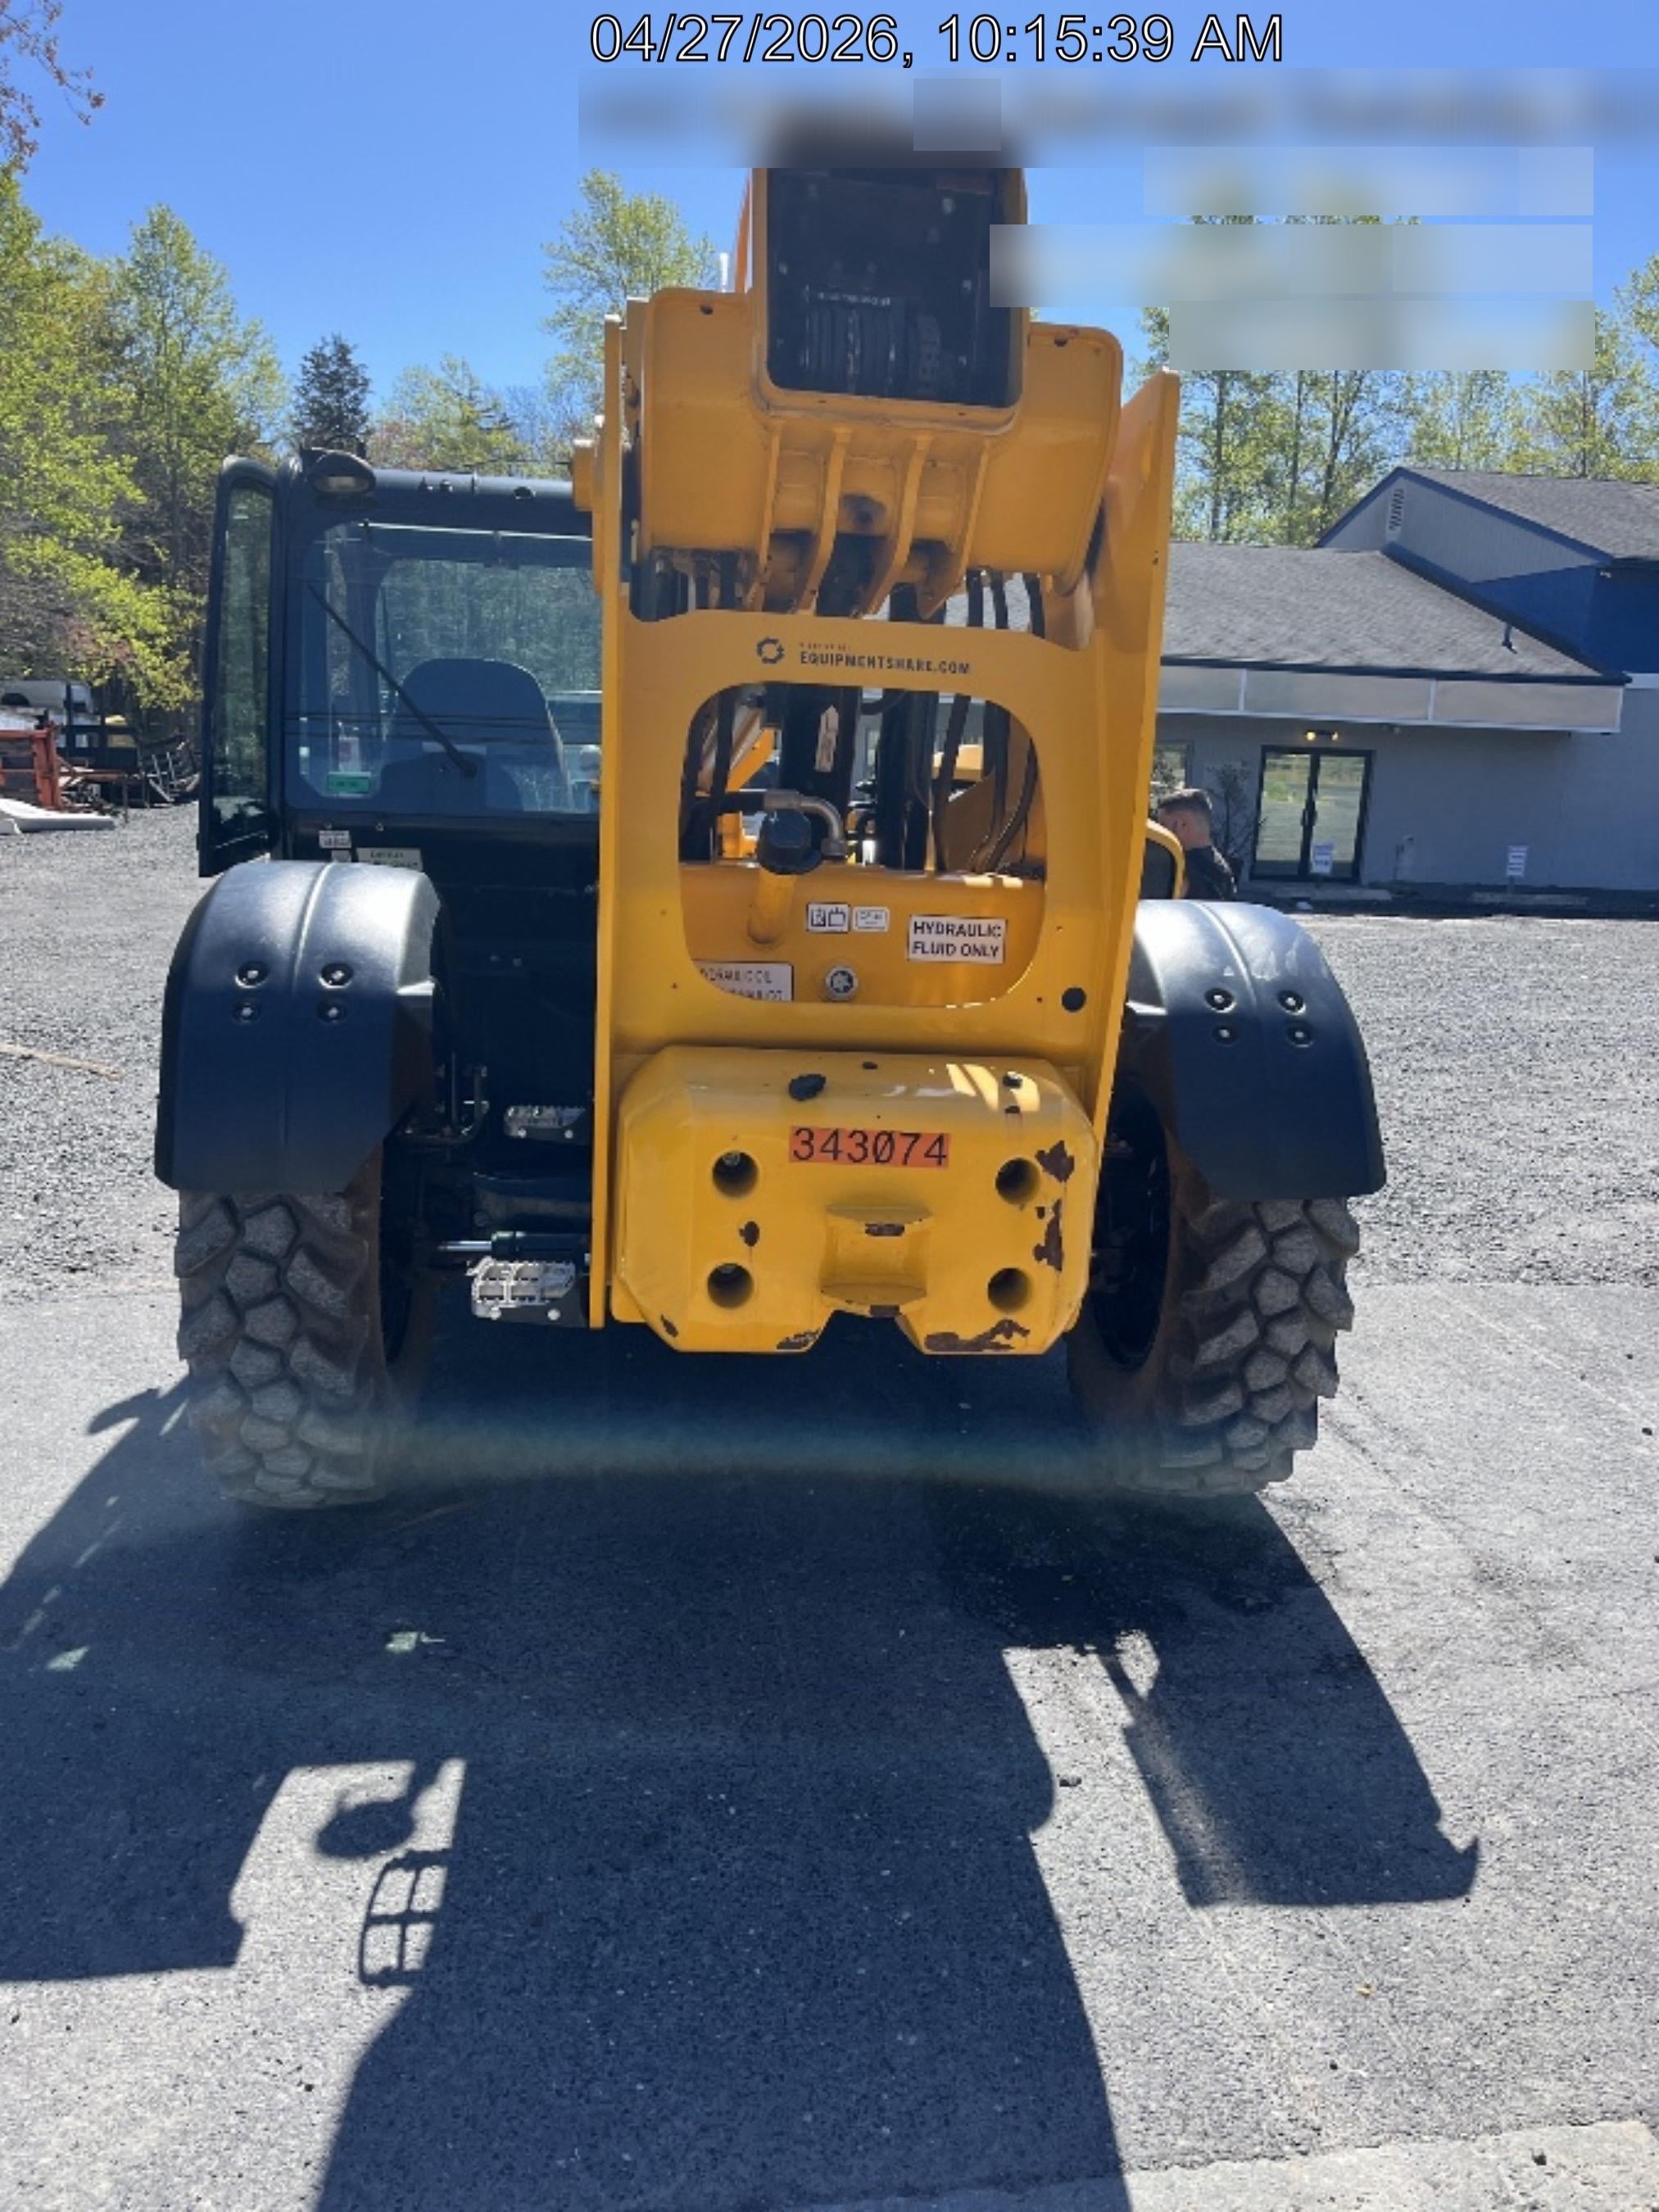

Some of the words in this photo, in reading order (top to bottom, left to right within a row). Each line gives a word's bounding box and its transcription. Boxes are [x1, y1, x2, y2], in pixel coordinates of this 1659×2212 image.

[913, 921, 1002, 937] HYDRAULIC
[912, 941, 957, 957] FLUID
[960, 943, 999, 958] ONLY
[792, 1126, 948, 1166] 343074
